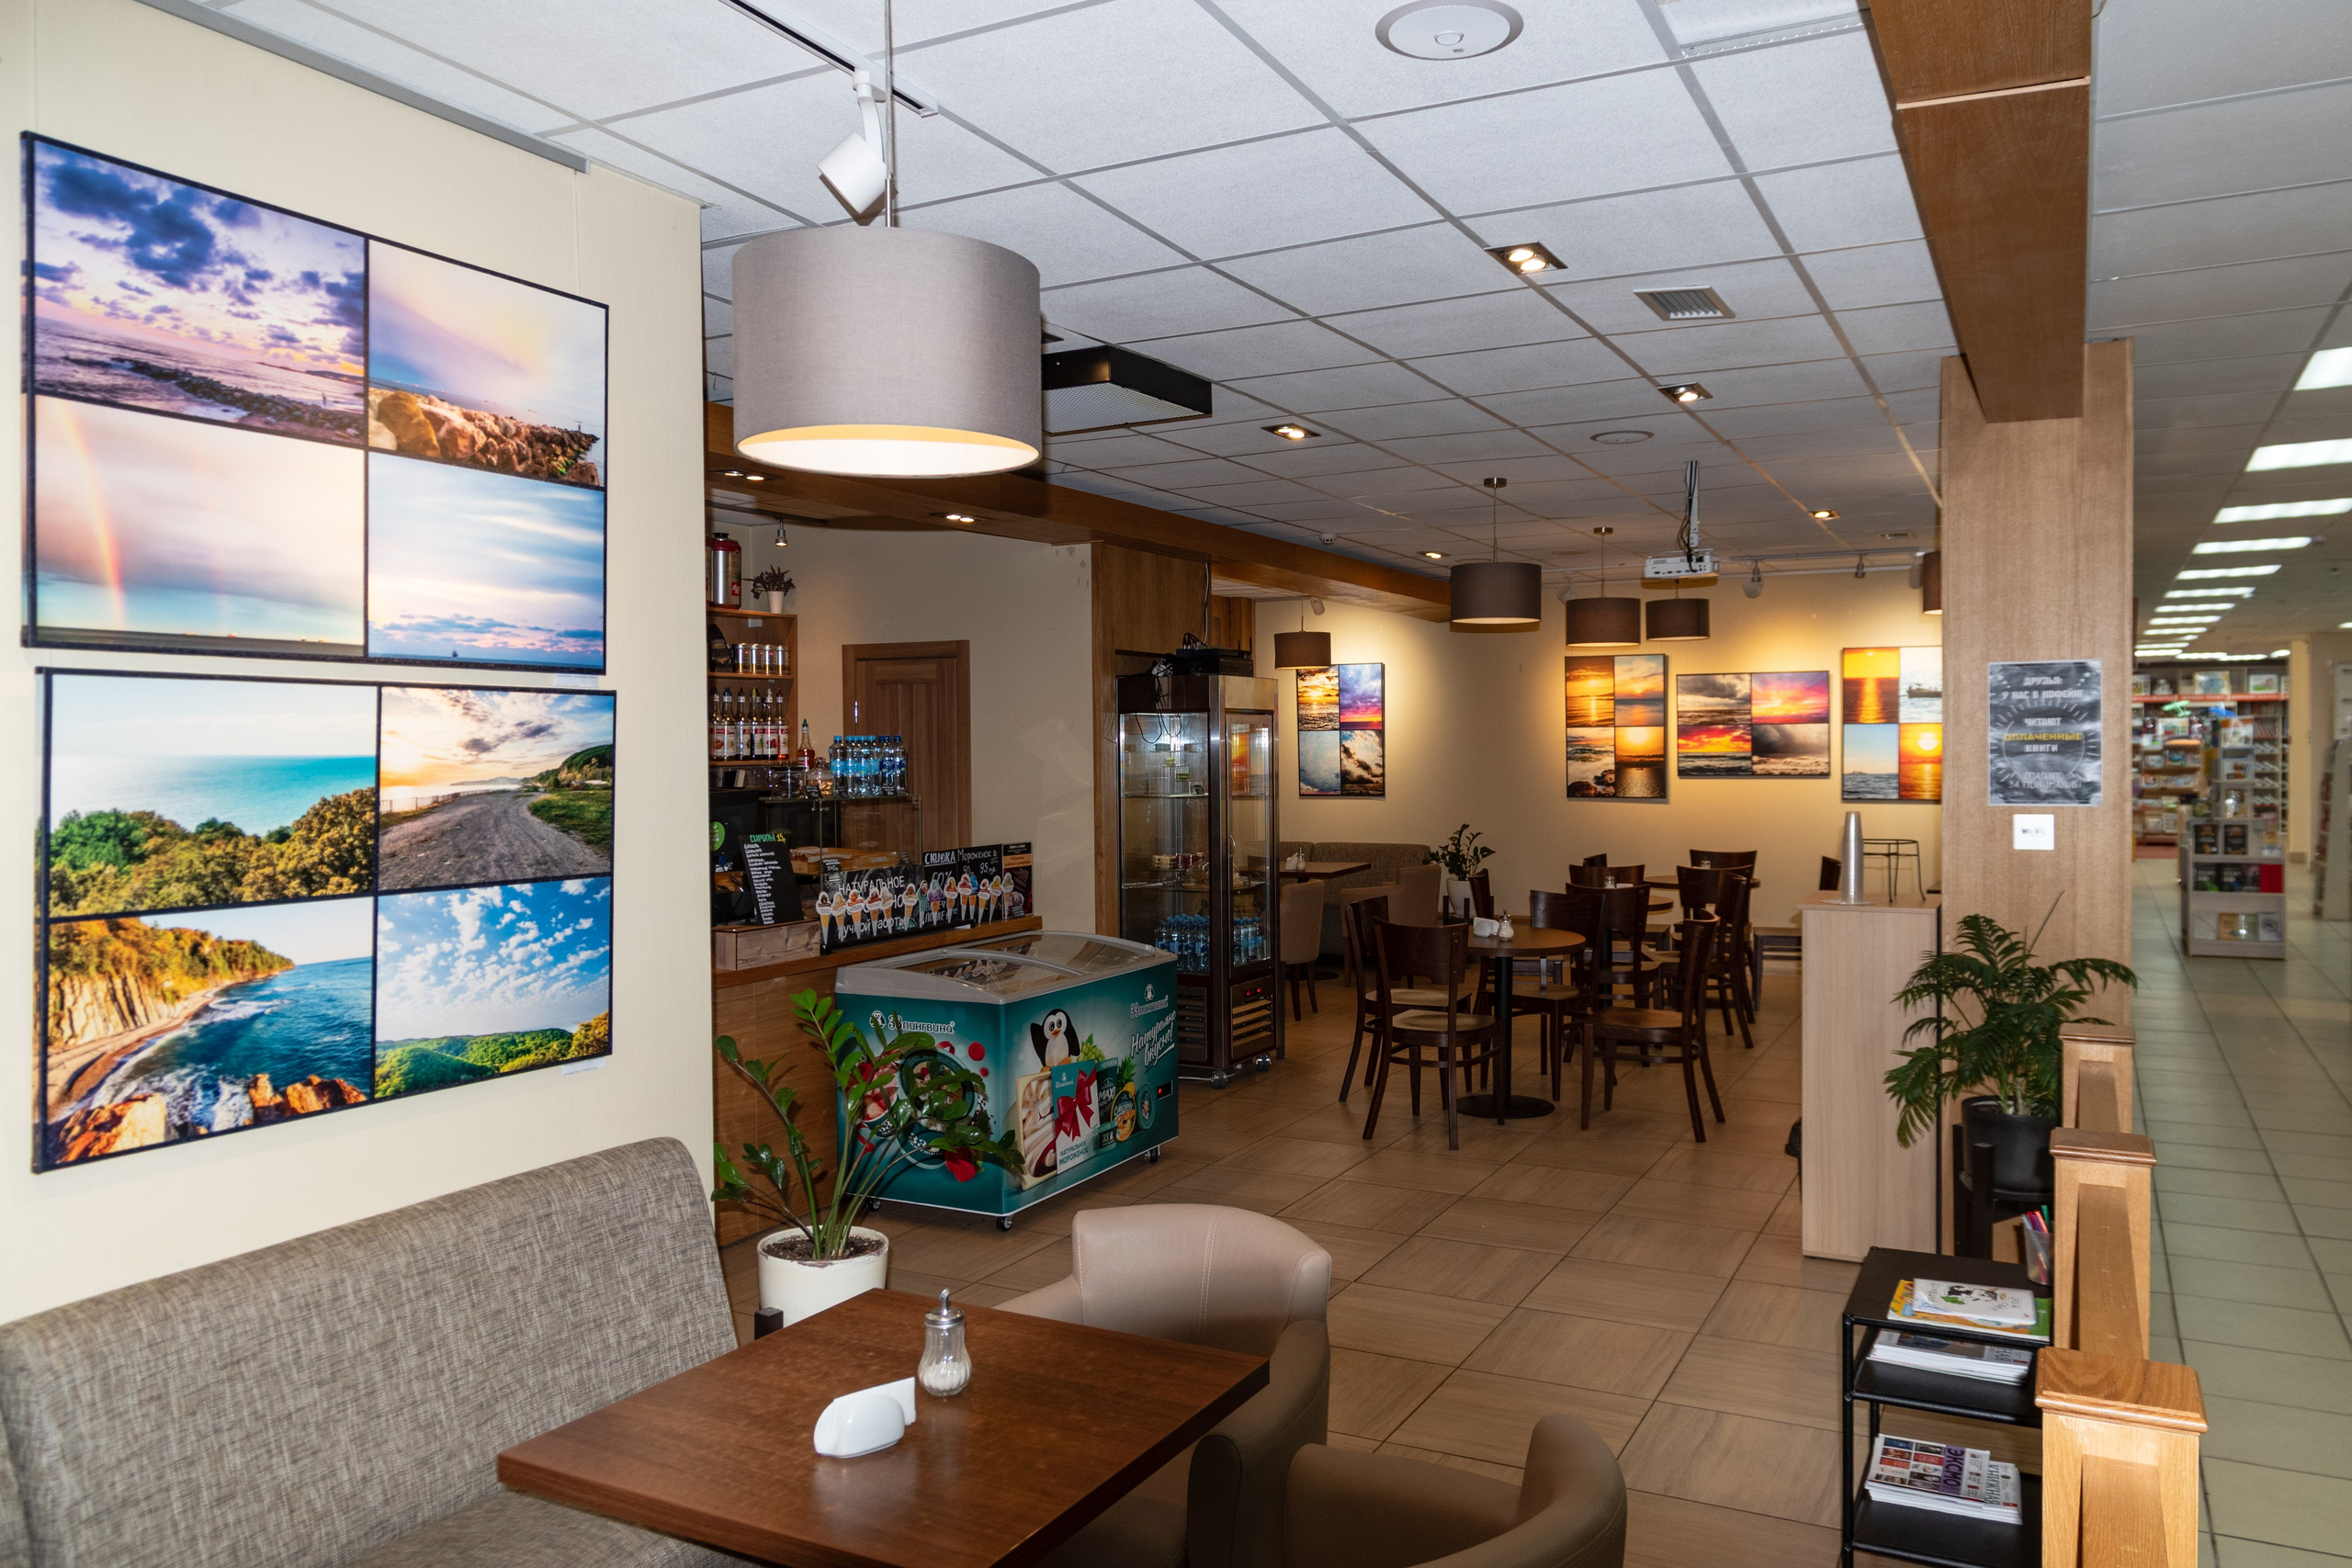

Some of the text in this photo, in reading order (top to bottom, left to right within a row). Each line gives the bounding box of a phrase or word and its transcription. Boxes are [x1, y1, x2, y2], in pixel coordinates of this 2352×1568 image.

[2012, 691, 2030, 699] НАС
[2032, 691, 2040, 699] В
[2024, 717, 2063, 727] ЧИТАЮТ
[2004, 732, 2083, 741] ОПЛАЧЕННЫЕ
[2025, 744, 2058, 752] КНИГИ
[2009, 781, 2020, 789] ЗА
[749, 833, 776, 842] СИРОПЫ
[957, 848, 991, 863] Мороженое
[979, 862, 989, 874] 95
[1098, 1086, 1116, 1101] MAXI
[1059, 1140, 1087, 1156] НАТУРАЛЬНОЕ
[1059, 1146, 1089, 1166] МОРОЖЕНОЕ
[1943, 1448, 1964, 1487] ЭКСМО
